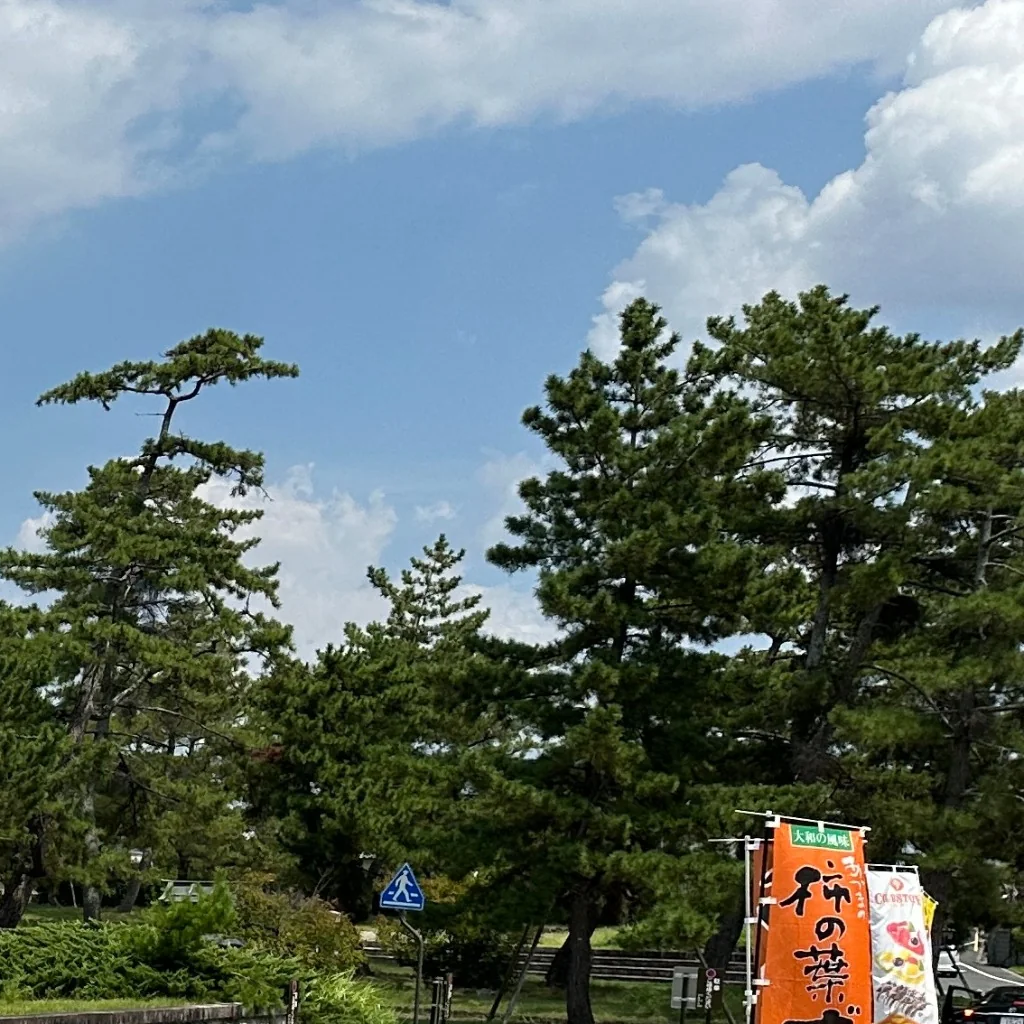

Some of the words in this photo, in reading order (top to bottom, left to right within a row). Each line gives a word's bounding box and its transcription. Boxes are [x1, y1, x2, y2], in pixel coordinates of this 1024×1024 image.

[793, 829, 850, 847] 大和の風味
